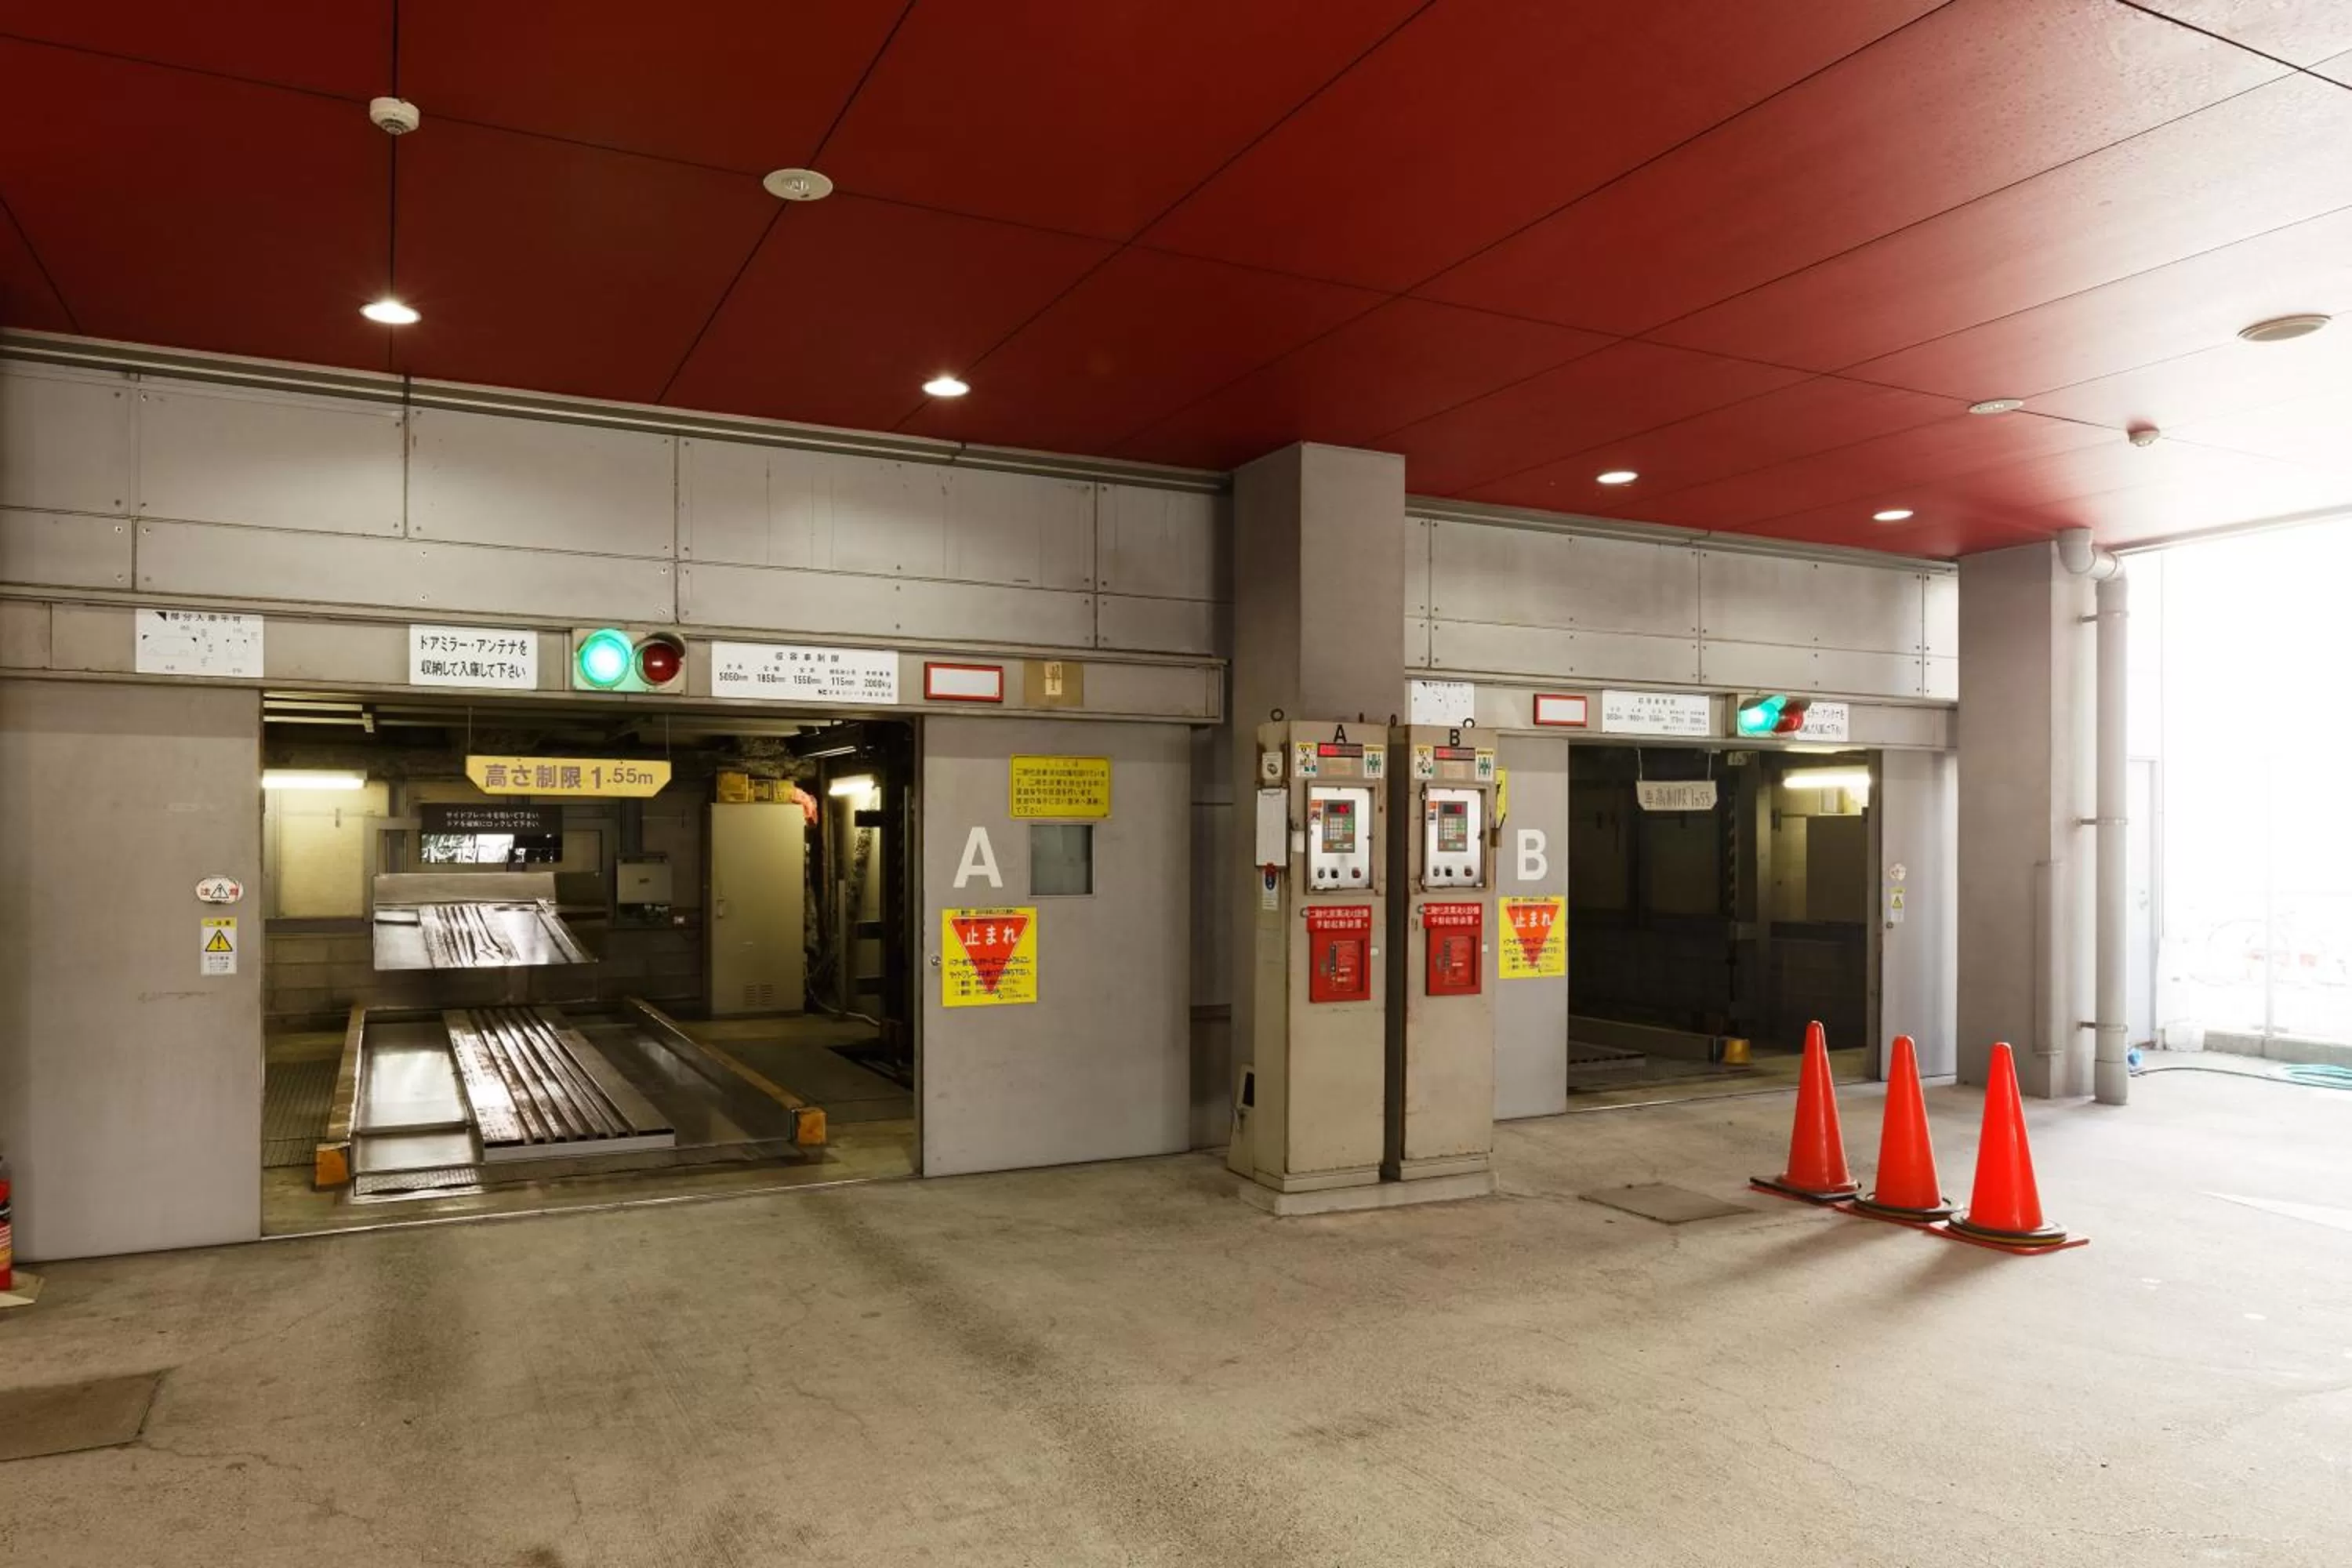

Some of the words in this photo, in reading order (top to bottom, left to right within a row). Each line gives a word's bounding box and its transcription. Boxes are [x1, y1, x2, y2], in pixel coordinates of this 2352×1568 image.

[420, 634, 528, 656] ドアミラー・アンテナを
[420, 659, 528, 680] 収納して入庫して下さい
[1333, 724, 1348, 742] A
[1450, 728, 1461, 746] B
[485, 764, 582, 789] 高さ制限
[590, 766, 655, 789] 1.55m
[953, 826, 1004, 888] A
[1517, 829, 1548, 880] B
[1515, 910, 1552, 928] 止まれ
[964, 924, 1018, 946] 止まれ
